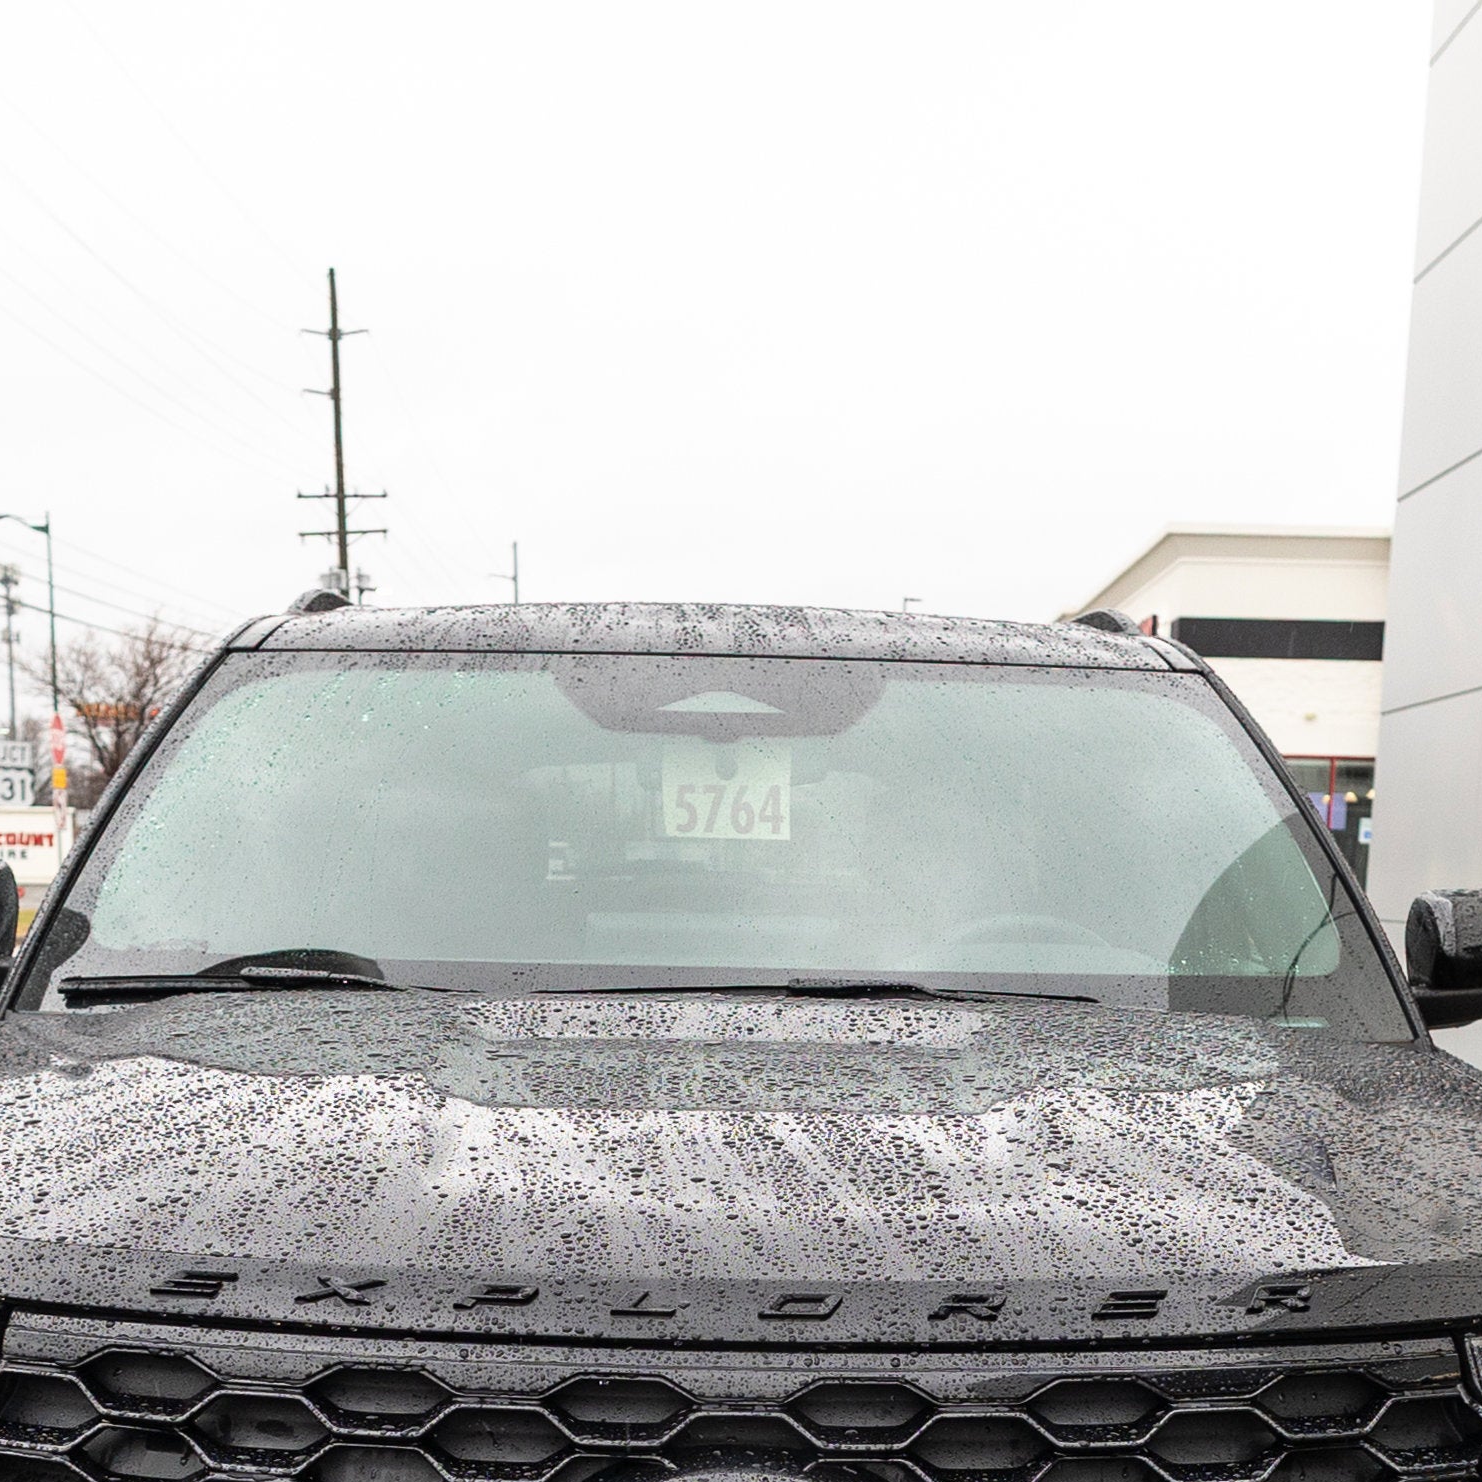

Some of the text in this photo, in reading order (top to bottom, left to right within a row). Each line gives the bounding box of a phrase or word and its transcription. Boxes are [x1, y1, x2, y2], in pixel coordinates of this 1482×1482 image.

[0, 744, 27, 761] JCT
[0, 777, 26, 802] 31
[675, 783, 784, 835] 5764
[149, 1270, 1314, 1321] EXPLORER
